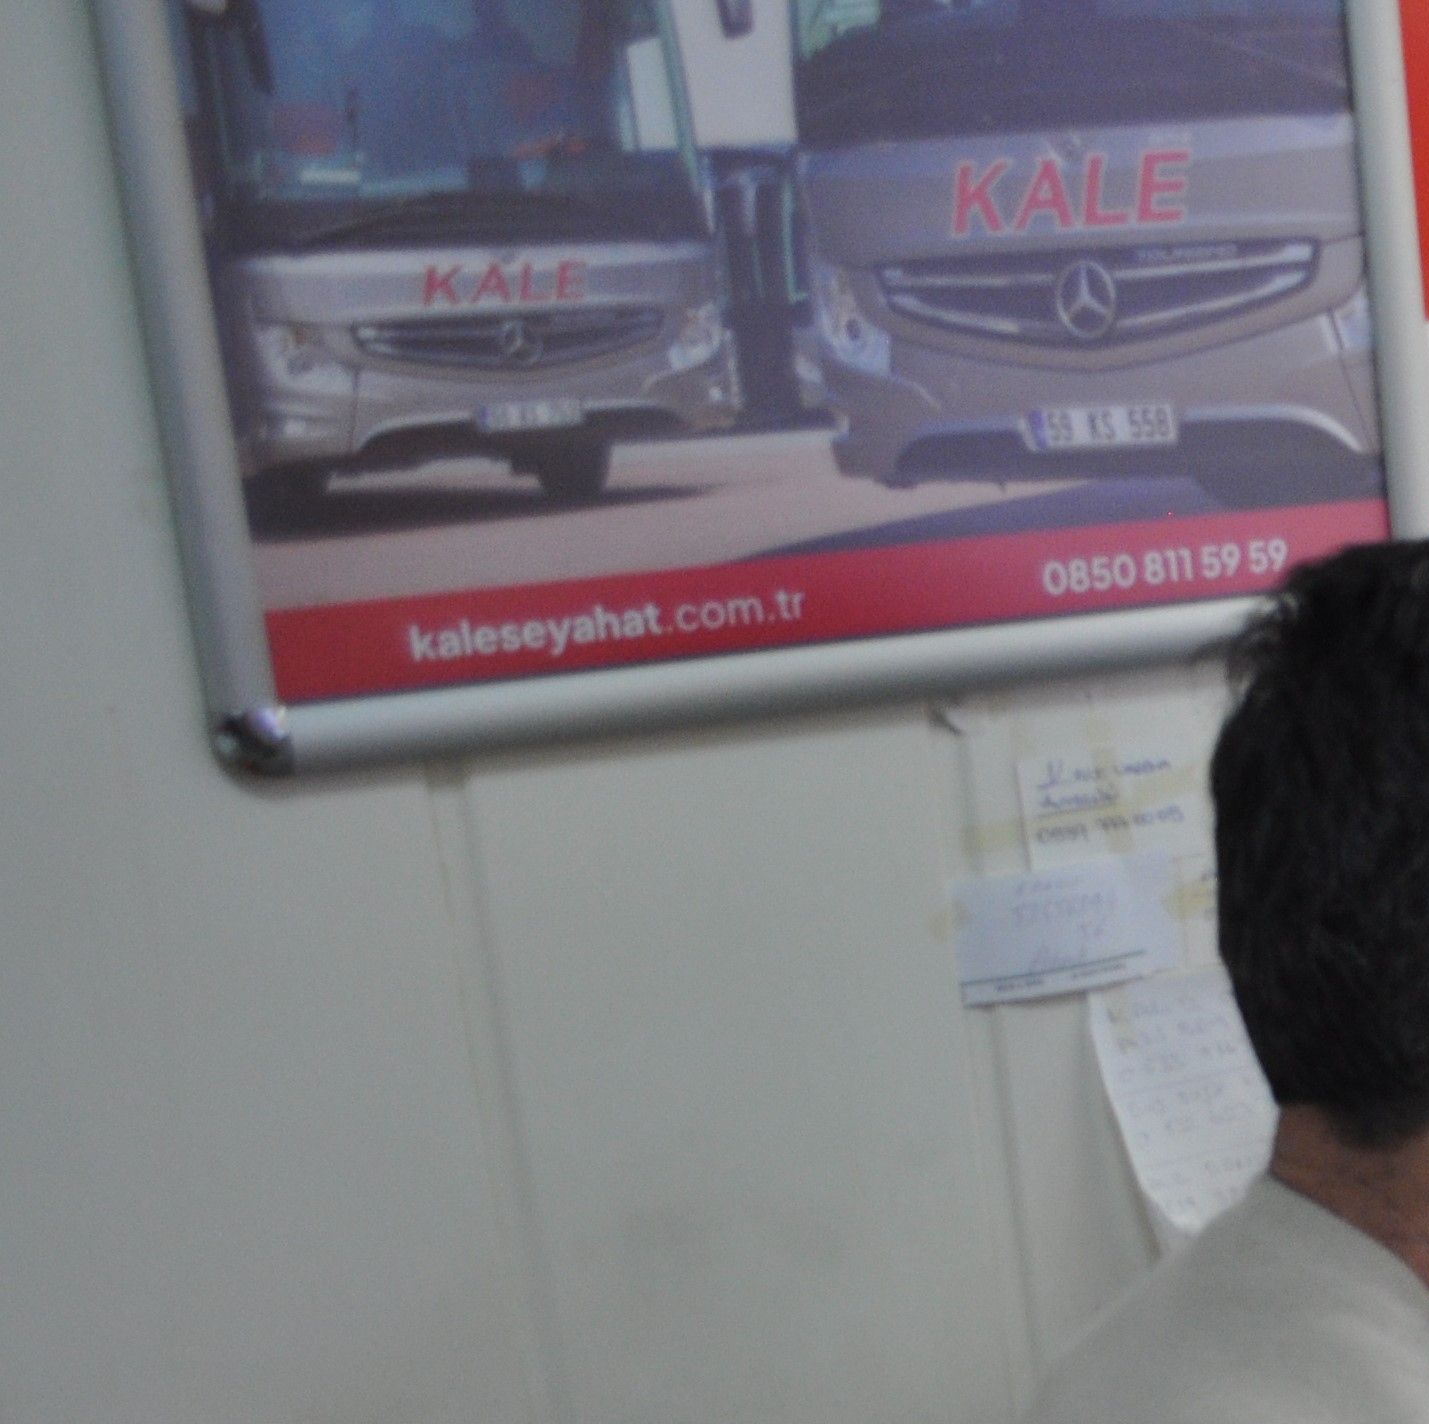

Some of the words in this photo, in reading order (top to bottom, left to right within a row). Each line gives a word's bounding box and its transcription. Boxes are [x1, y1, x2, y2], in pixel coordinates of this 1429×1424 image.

[950, 149, 1189, 237] KALE
[421, 258, 592, 308] KALE
[1042, 552, 1138, 597] 0850
[1143, 546, 1195, 586] 811
[1200, 542, 1242, 580] 59
[1248, 537, 1289, 575] 59
[408, 590, 806, 664] kaleseyahat.com.tr
